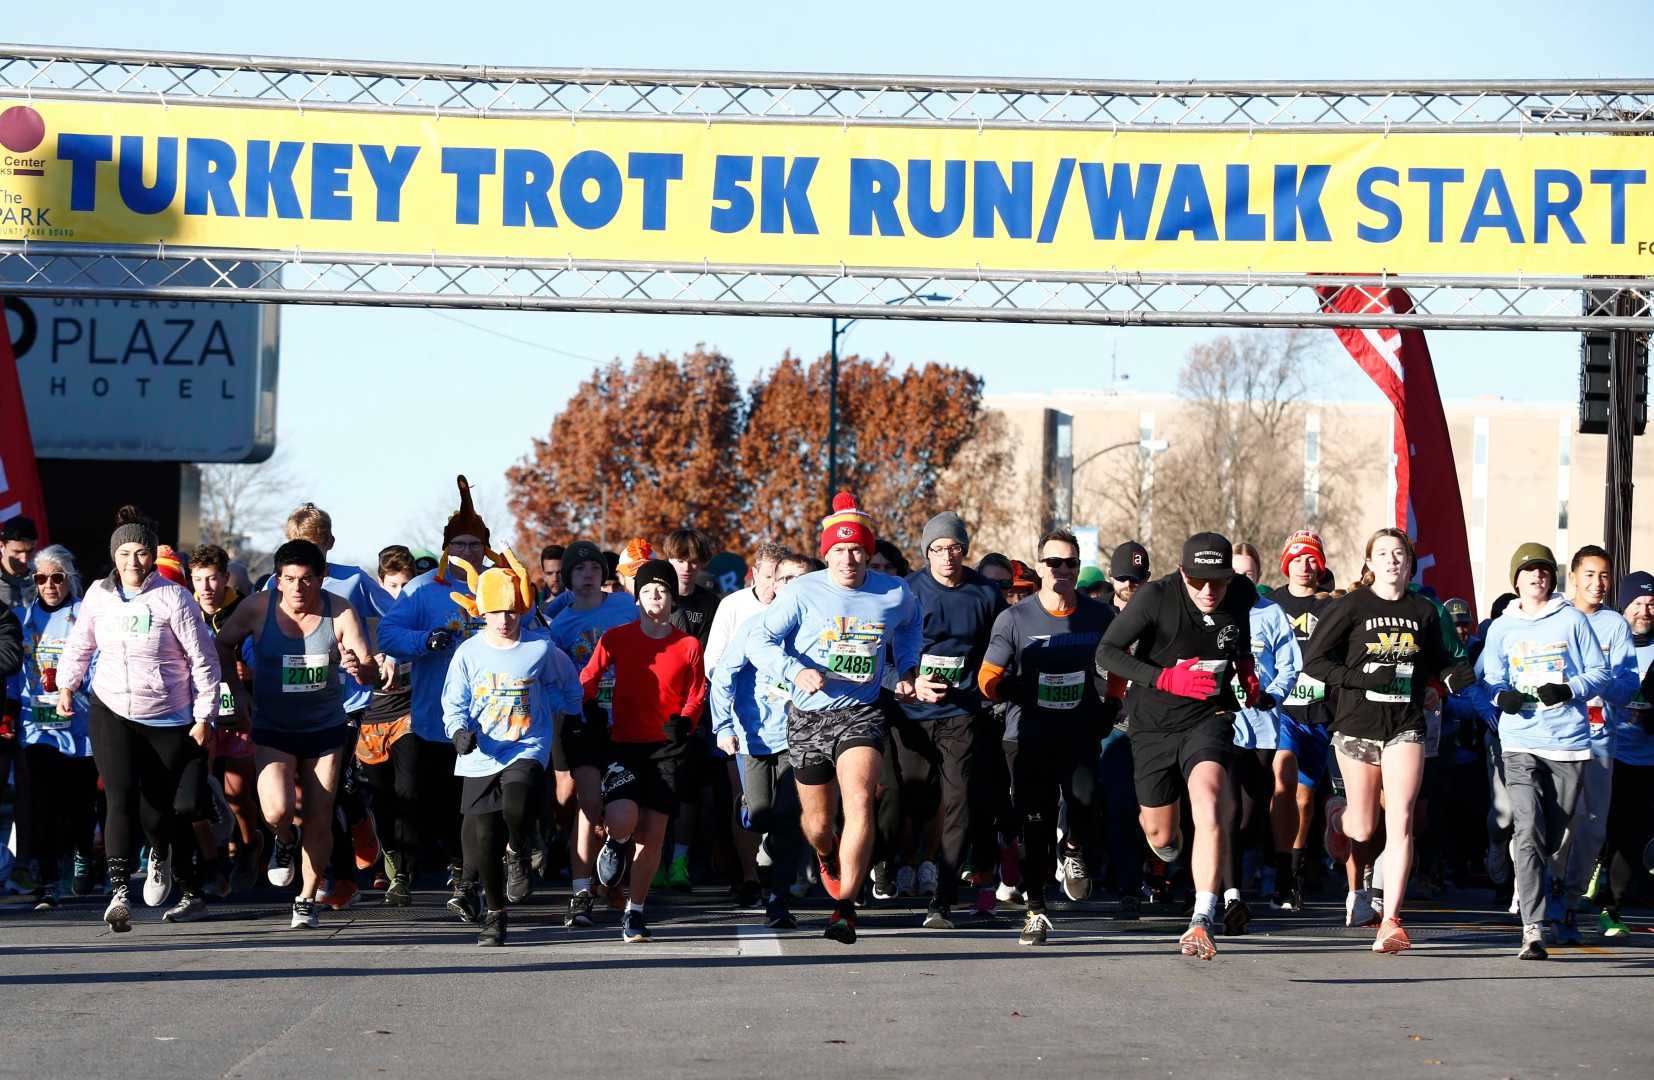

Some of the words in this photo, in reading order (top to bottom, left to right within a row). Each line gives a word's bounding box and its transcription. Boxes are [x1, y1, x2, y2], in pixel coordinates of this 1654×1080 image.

[4, 156, 46, 168] Center
[57, 133, 420, 222] TURKEY
[441, 147, 683, 231] TROT
[710, 155, 818, 235] 5K
[850, 158, 1331, 244] RUN/WALK
[1356, 167, 1646, 245] START
[51, 317, 236, 367] PLAZA
[50, 376, 236, 399] HOTEL
[287, 666, 324, 685] 2708
[833, 654, 872, 675] 2485
